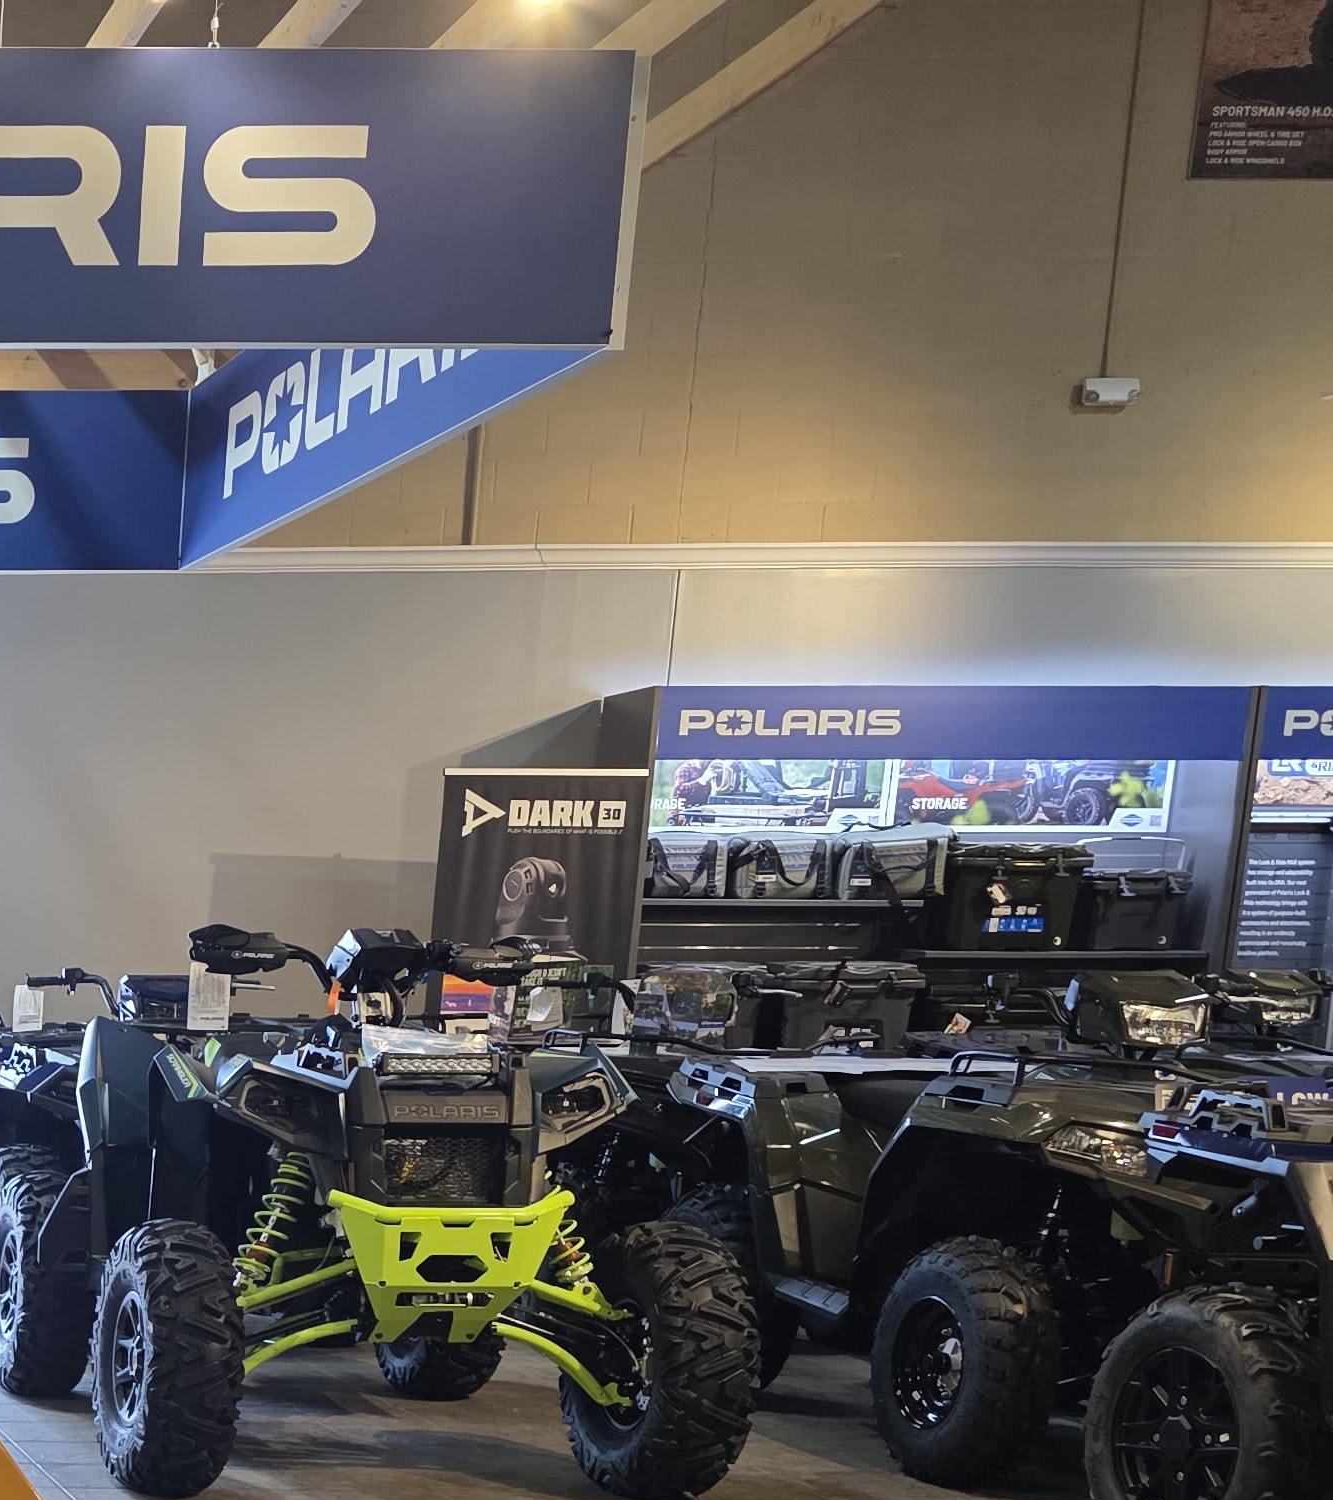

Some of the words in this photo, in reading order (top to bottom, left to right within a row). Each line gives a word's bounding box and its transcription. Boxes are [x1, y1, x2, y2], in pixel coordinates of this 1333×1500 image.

[1212, 105, 1285, 117] SPORTSMAN
[1287, 105, 1310, 117] 450
[678, 709, 902, 736] POLARIS
[911, 797, 968, 810] STORAGE
[507, 799, 595, 827] DARK
[602, 808, 622, 820] 30
[242, 951, 275, 959] POLARIS
[166, 1053, 192, 1088] SCRAMBLER
[394, 1105, 500, 1119] POLARIS
